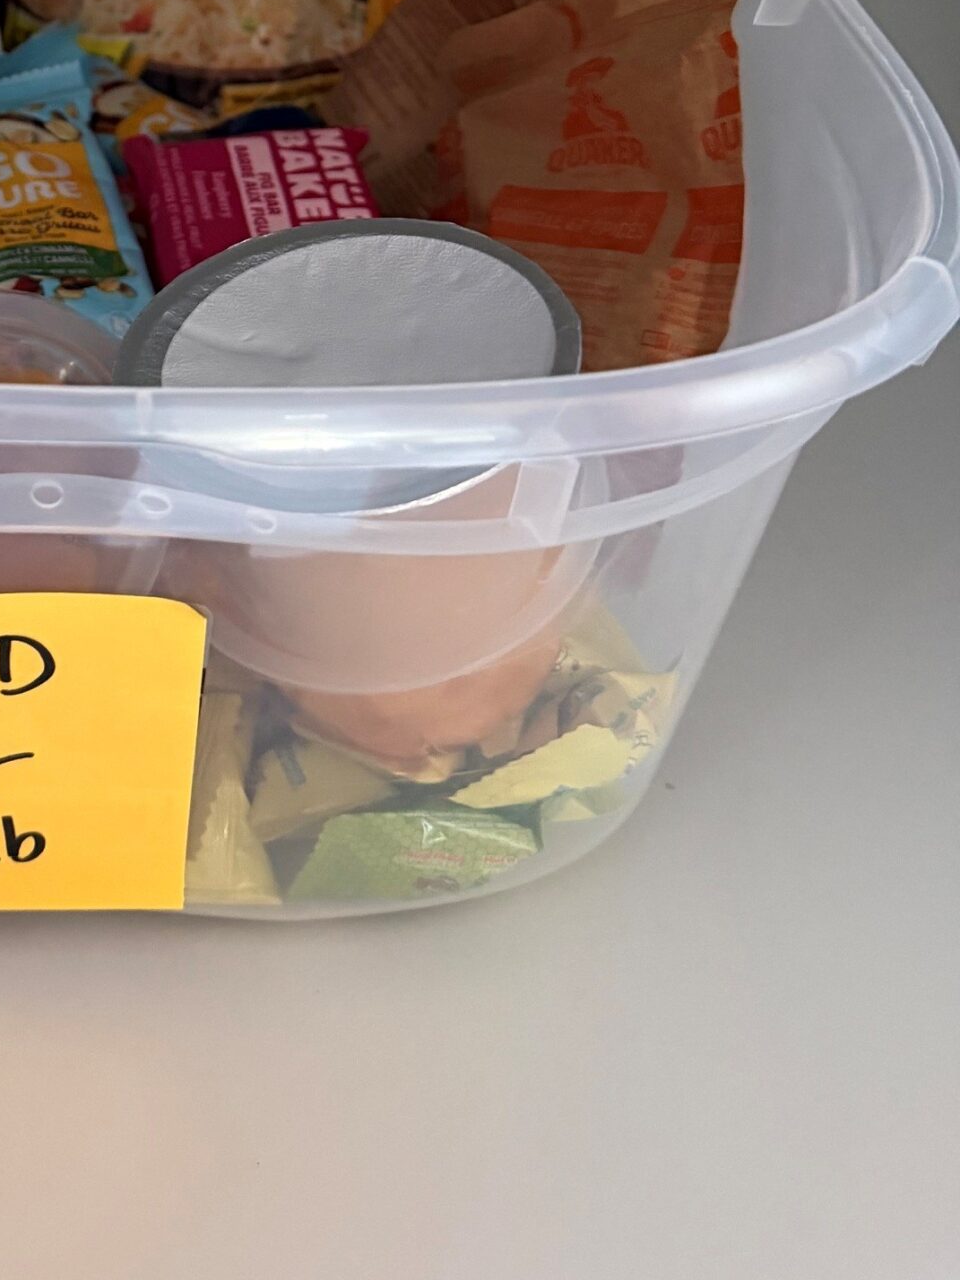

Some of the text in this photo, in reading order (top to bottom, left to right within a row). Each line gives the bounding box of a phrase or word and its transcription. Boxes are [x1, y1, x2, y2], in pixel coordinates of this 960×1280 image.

[242, 180, 262, 206] AUX
[256, 171, 283, 216] FIG BAR
[271, 130, 333, 226] BAKE
[250, 206, 271, 237] FIGU
